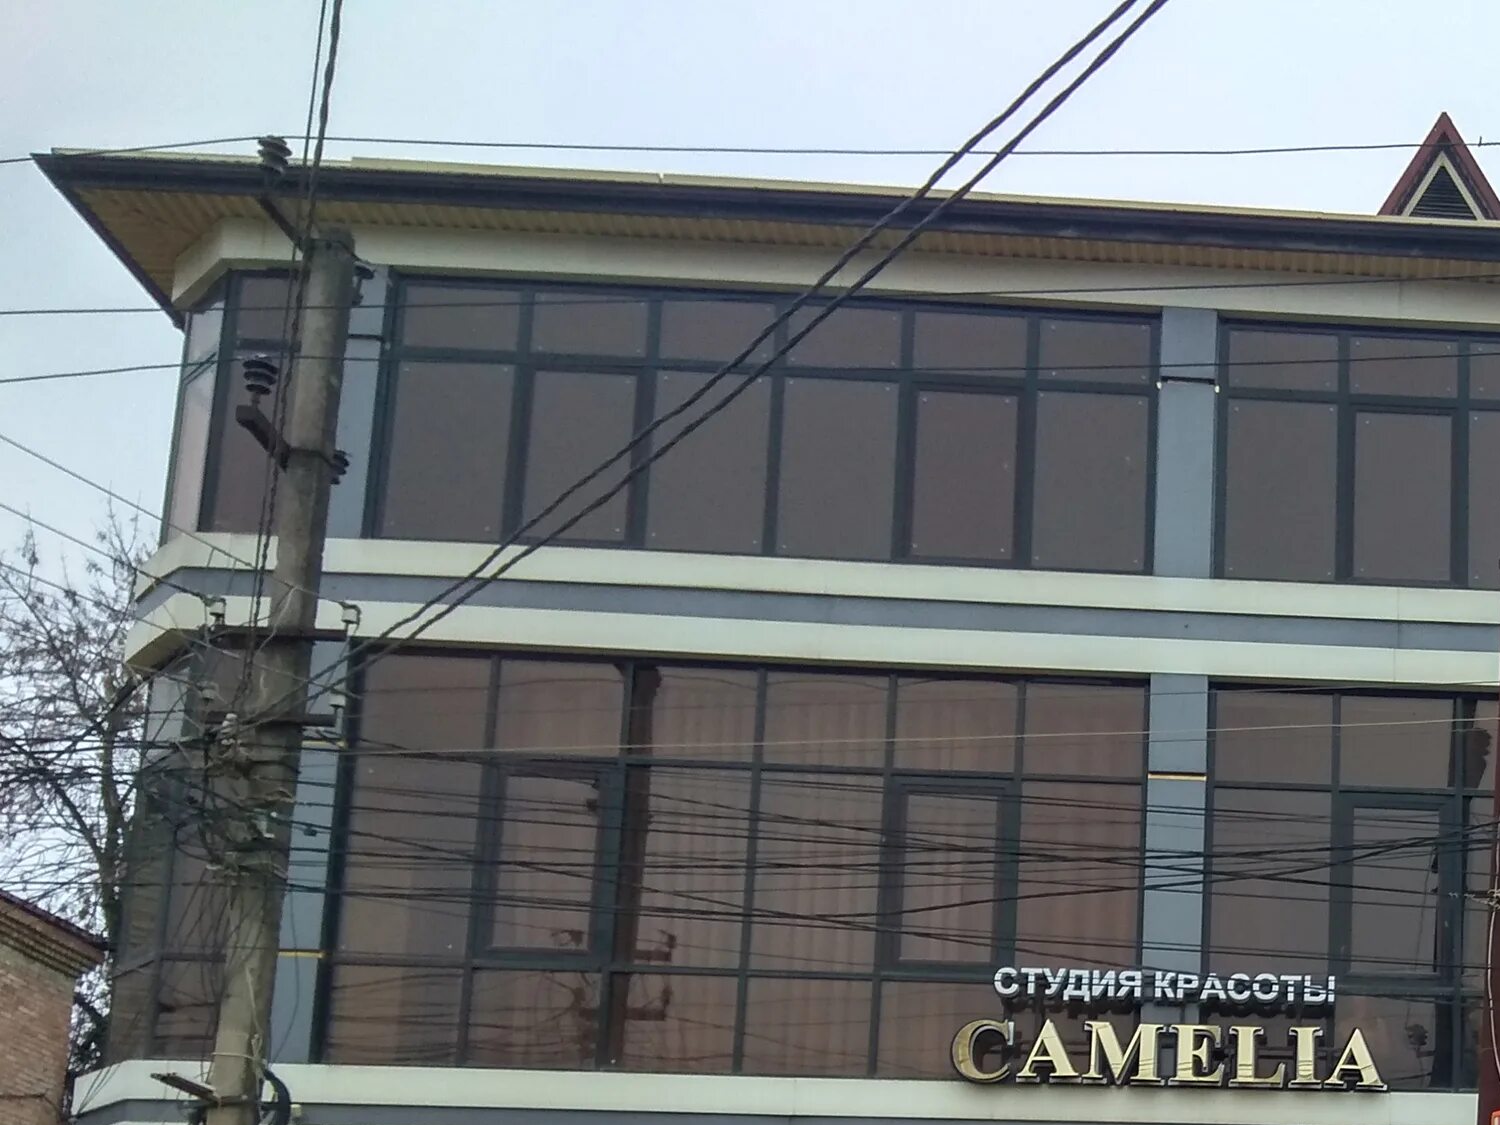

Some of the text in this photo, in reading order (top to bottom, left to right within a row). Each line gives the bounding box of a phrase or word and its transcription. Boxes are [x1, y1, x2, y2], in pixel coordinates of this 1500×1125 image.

[993, 966, 1337, 1005] СТУДИЯ КРАСОТЫ
[948, 1017, 1388, 1092] CAMELIA
